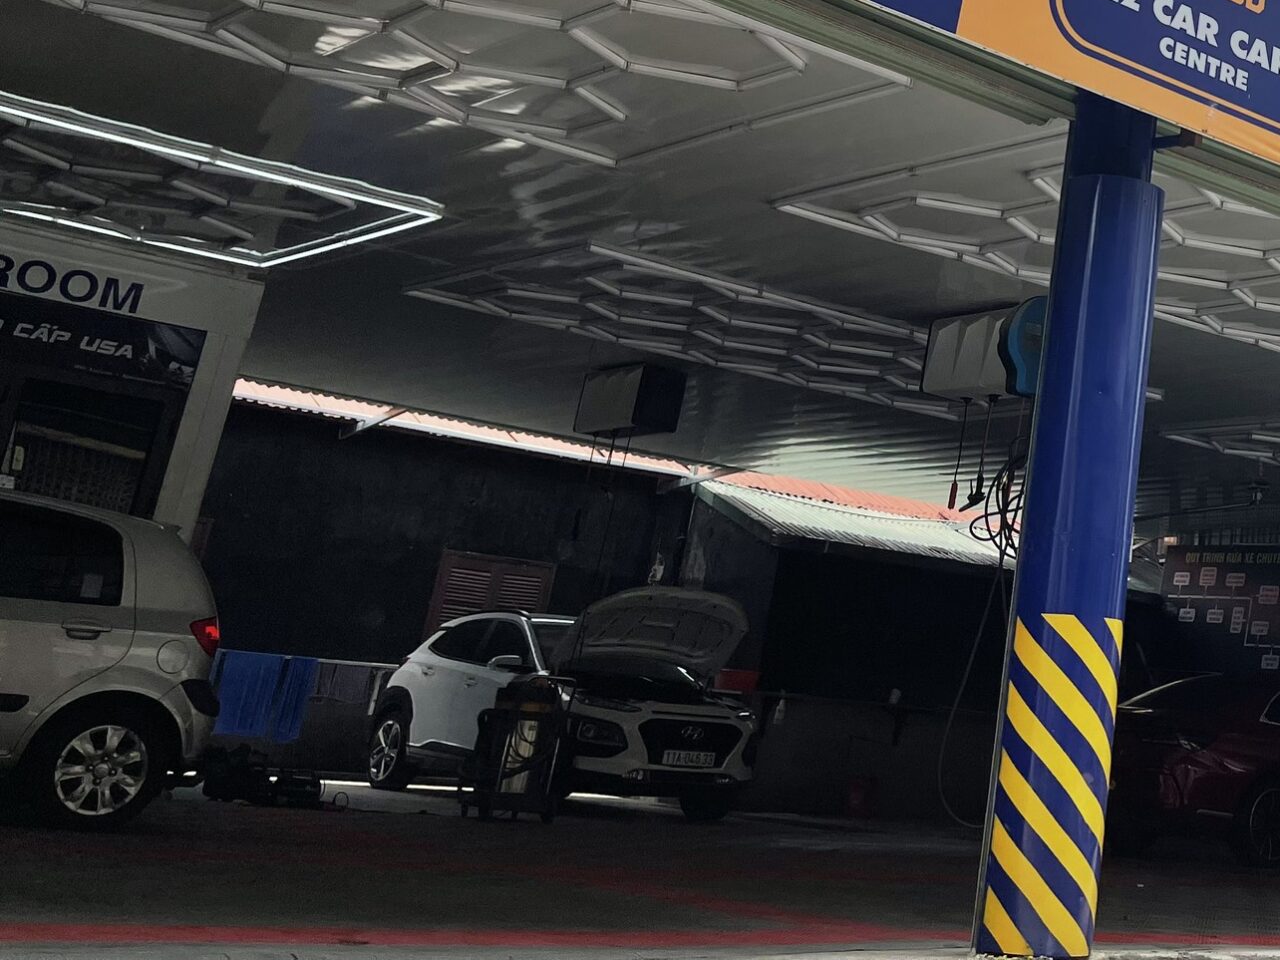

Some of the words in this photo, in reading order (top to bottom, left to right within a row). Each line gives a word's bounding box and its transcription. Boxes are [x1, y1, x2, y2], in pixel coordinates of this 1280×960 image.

[1158, 37, 1249, 91] CENTRE
[13, 321, 72, 344] CẤP
[80, 336, 134, 359] USA
